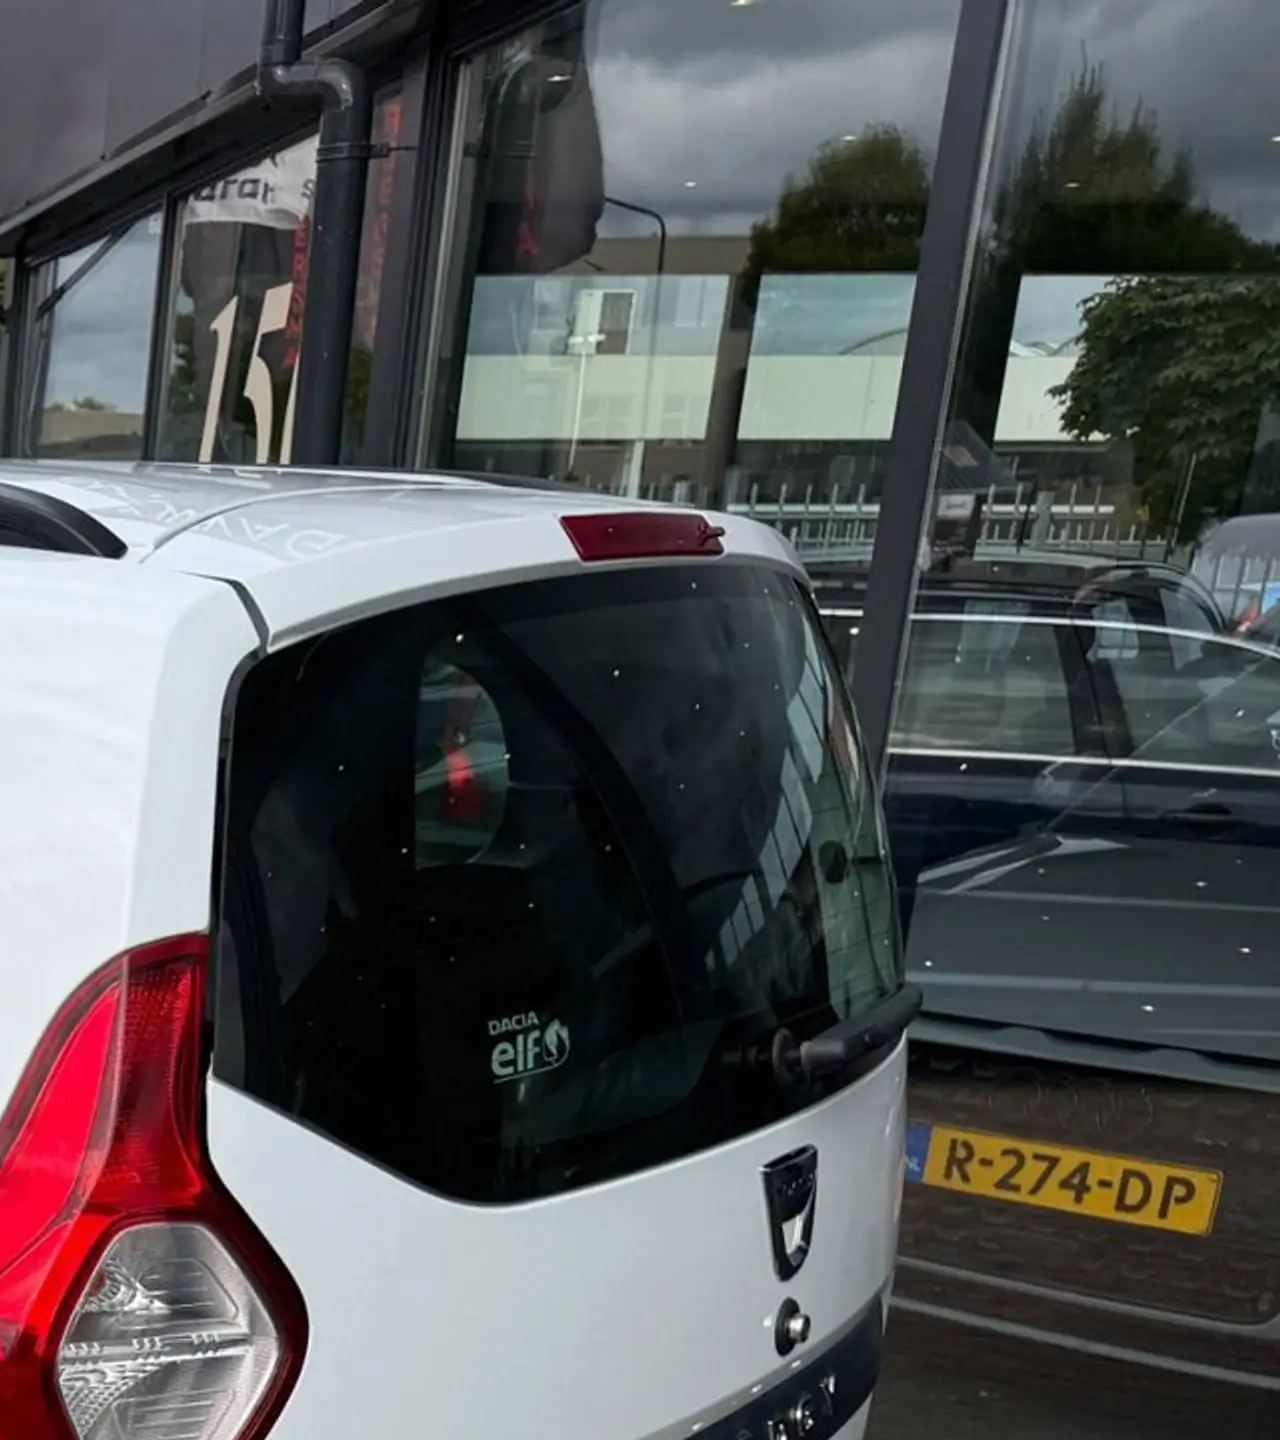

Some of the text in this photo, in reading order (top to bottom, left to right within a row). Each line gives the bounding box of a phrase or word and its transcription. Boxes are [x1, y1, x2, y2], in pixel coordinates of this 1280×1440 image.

[488, 1011, 540, 1036] DACIA
[491, 1029, 541, 1076] elf
[942, 1137, 1197, 1221] R-274-DP
